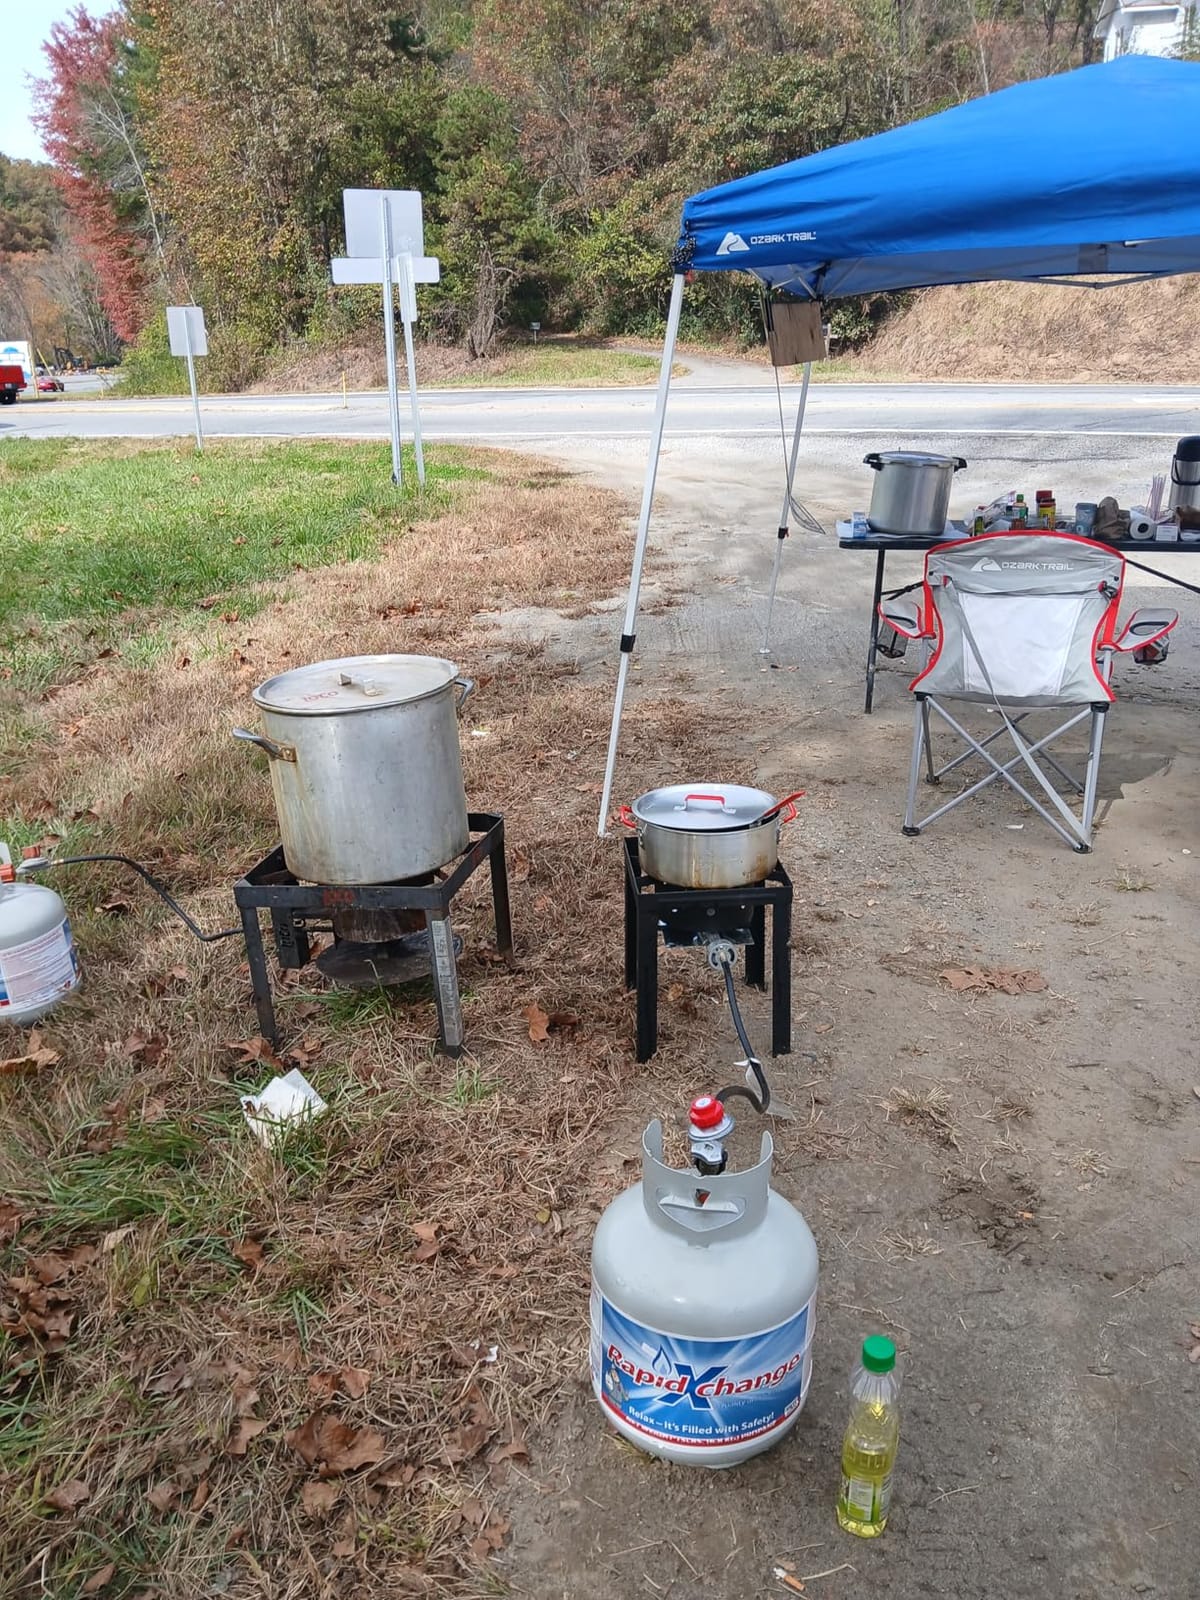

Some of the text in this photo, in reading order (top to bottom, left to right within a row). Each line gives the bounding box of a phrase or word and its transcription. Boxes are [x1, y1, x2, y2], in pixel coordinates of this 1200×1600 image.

[750, 234, 785, 245] OZARK
[1001, 561, 1074, 571] OZARK TRAIL
[628, 1405, 655, 1426] Relax
[682, 1424, 713, 1435] Filled
[715, 1424, 739, 1435] with
[741, 1411, 775, 1431] Safety!
